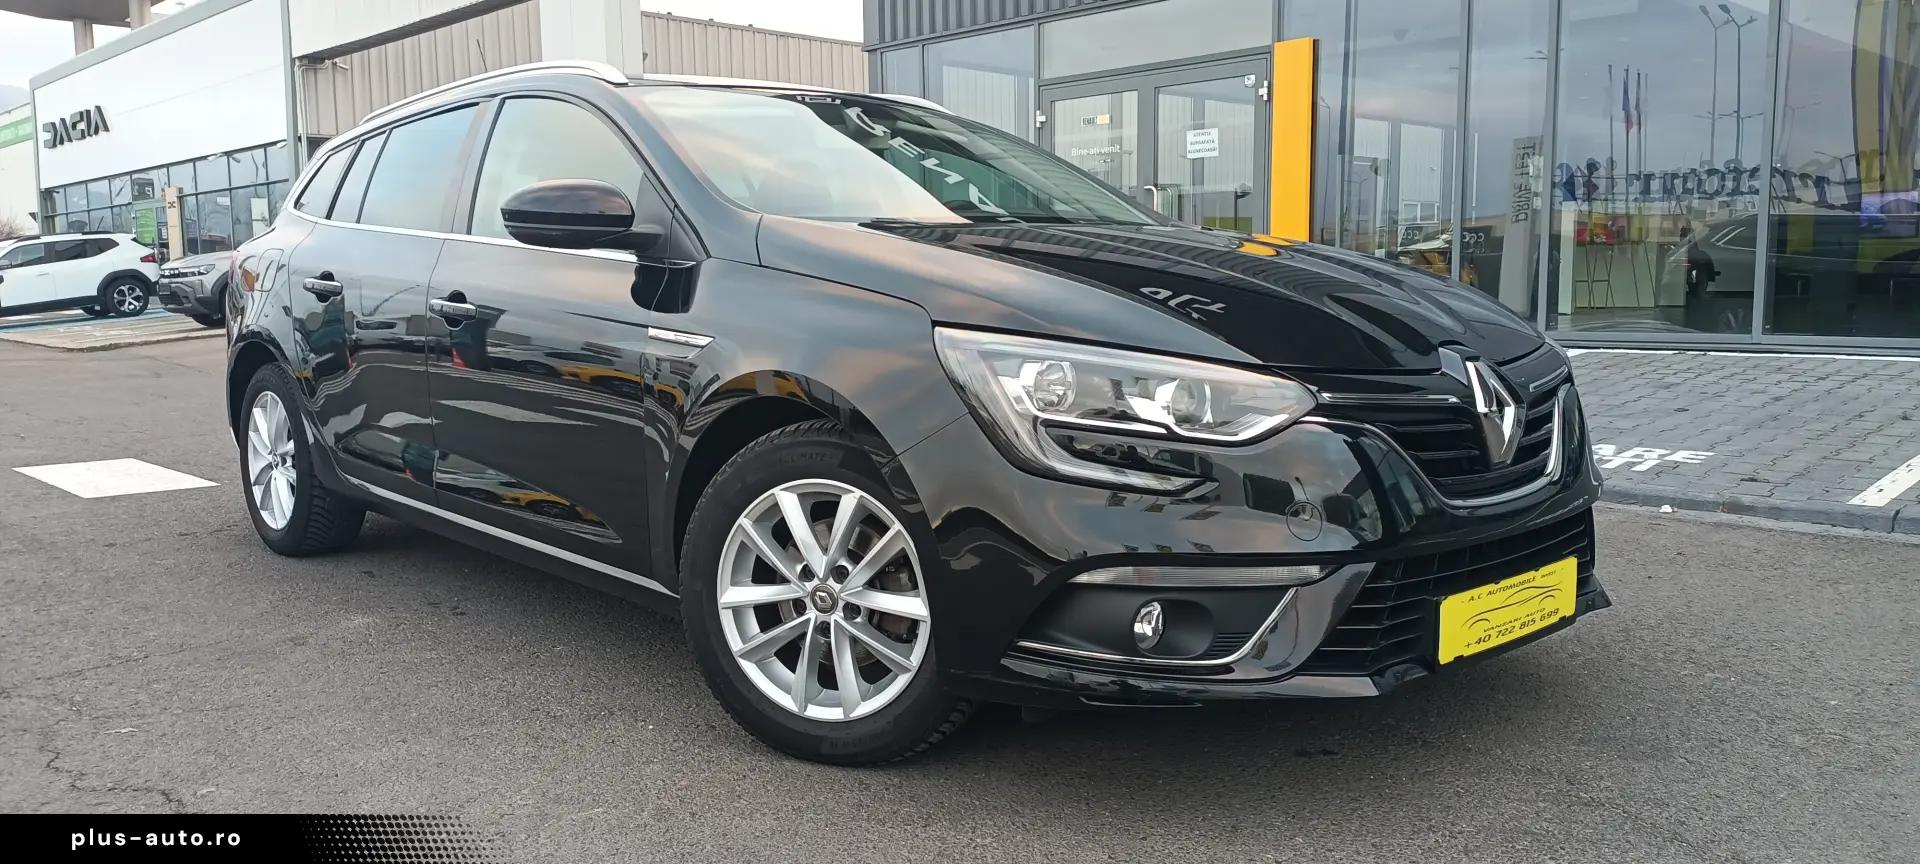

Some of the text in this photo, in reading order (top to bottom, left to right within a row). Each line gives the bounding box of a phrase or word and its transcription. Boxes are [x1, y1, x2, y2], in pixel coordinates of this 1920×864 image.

[1071, 147, 1088, 157] Bine
[1101, 143, 1121, 154] venit
[1485, 575, 1537, 597] AUTOMOBILE
[1540, 570, 1557, 579] INVEST
[1464, 607, 1560, 649] +40 722 815 699
[1483, 607, 1546, 633] VANZARI AUTO
